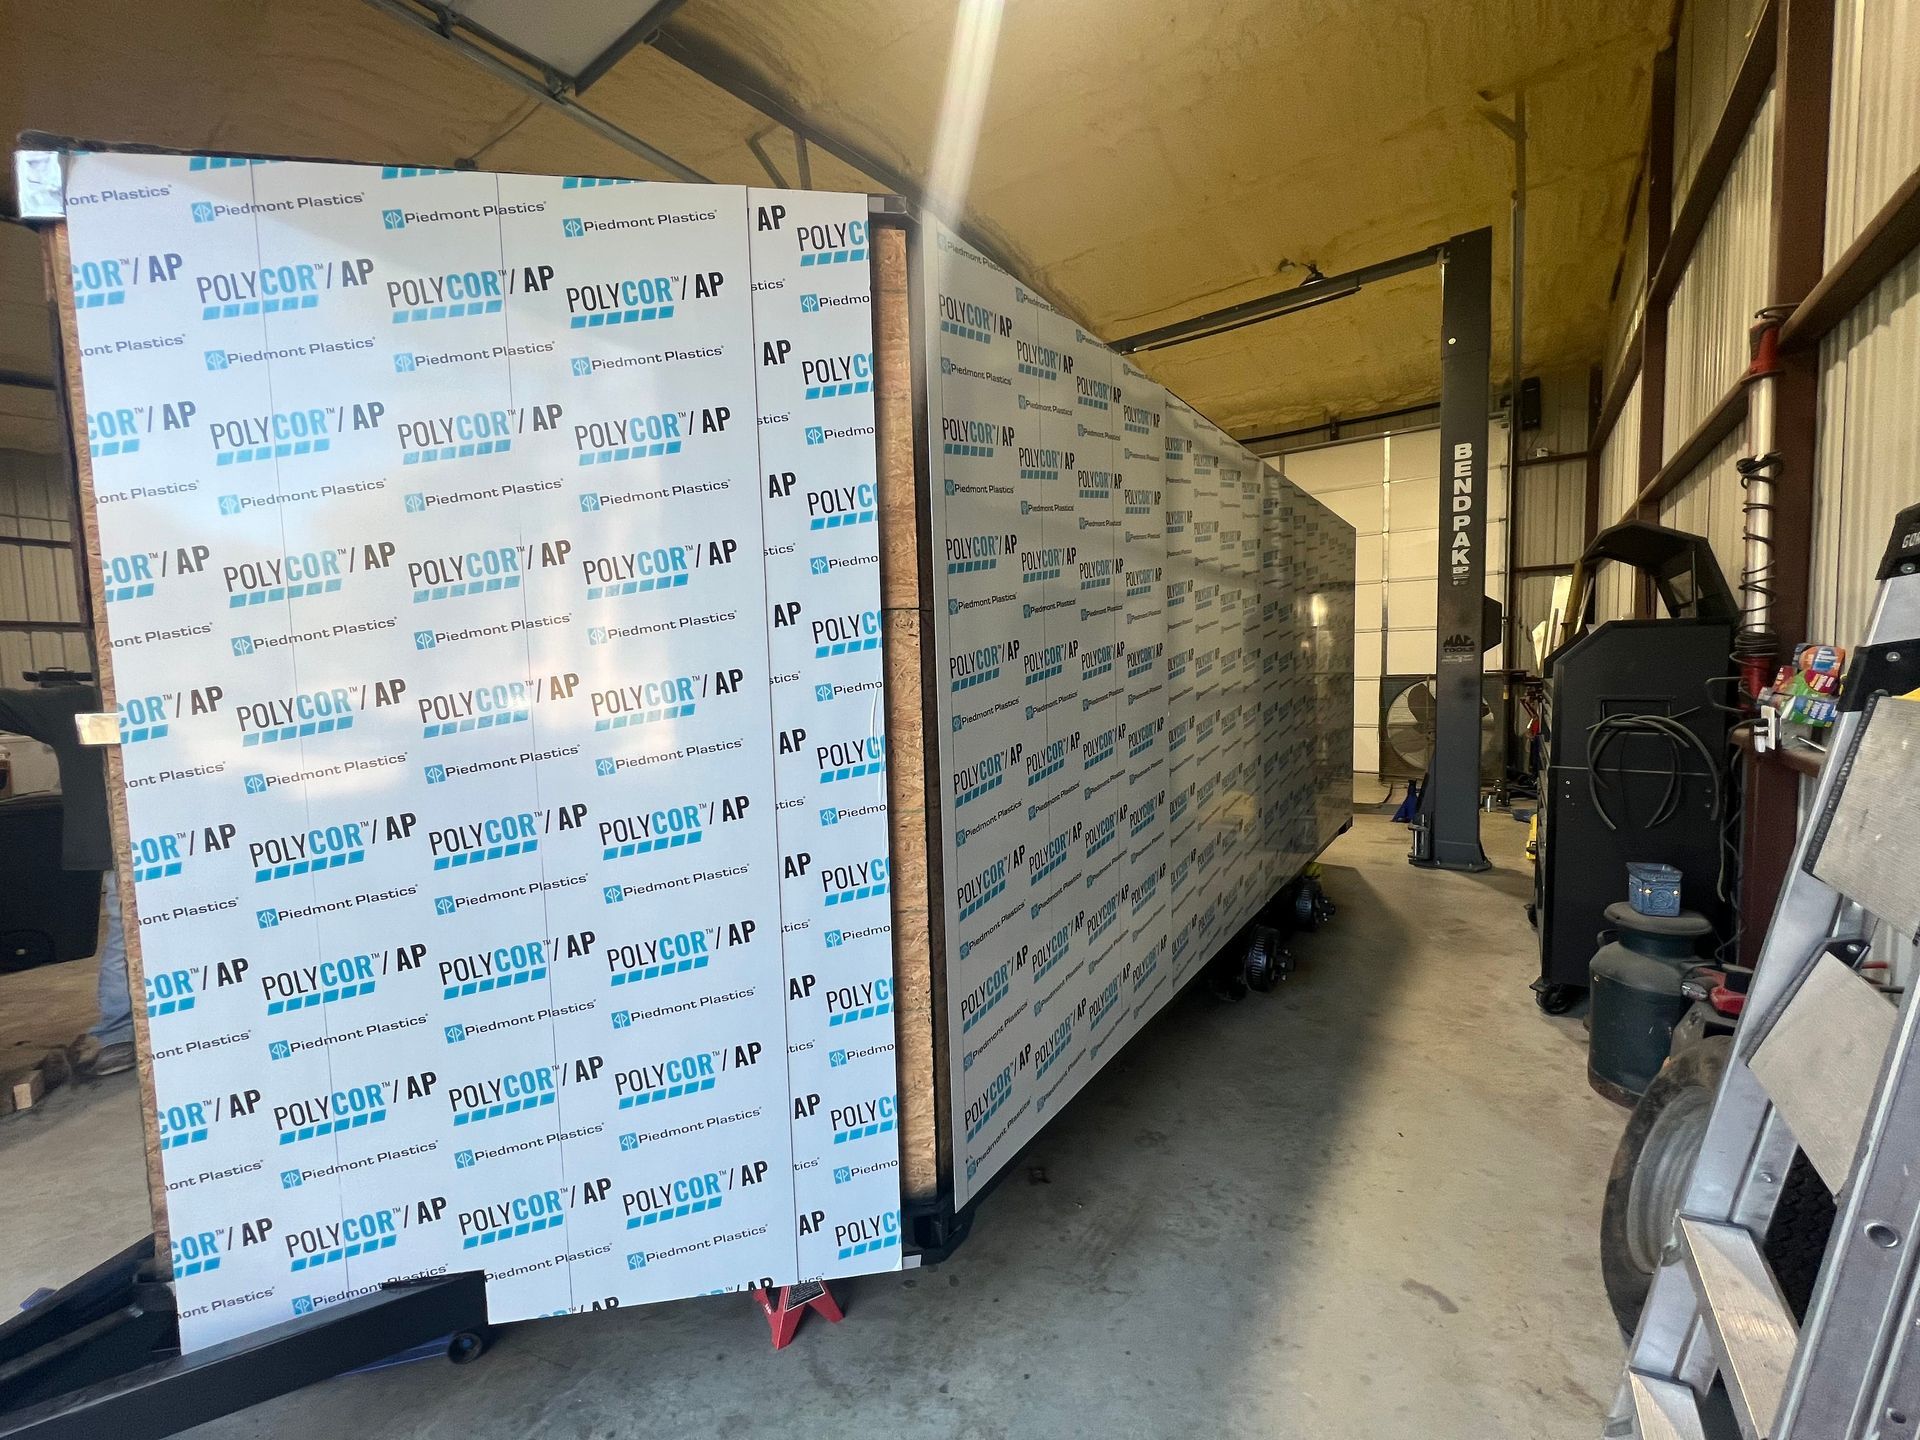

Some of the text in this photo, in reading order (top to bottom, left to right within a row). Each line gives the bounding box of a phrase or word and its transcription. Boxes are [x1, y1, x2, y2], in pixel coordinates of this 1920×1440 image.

[213, 200, 294, 217] Piedmont
[402, 207, 479, 224] Piedmont
[582, 214, 654, 231] Piedmont
[226, 346, 306, 364] Piedmont
[413, 349, 489, 367] Piedmont
[590, 352, 662, 370] Piedmont
[951, 364, 986, 381] Piedmont
[239, 489, 319, 508] Piedmont
[424, 488, 499, 507] Piedmont
[598, 487, 669, 506] Piedmont
[1451, 442, 1473, 565] BENDPAK
[958, 597, 992, 611] Piedmont
[252, 628, 330, 649] Piedmont
[434, 624, 508, 644] Piedmont
[607, 619, 677, 639] Piedmont
[445, 756, 518, 778] Piedmont
[615, 748, 684, 769] Piedmont
[265, 765, 342, 787] Piedmont
[965, 814, 998, 839] Piedmont
[623, 875, 691, 896] Piedmont
[454, 886, 527, 908] Piedmont
[277, 898, 353, 921] Piedmont
[630, 999, 698, 1021] Piedmont
[464, 1013, 536, 1036] Piedmont
[289, 1028, 364, 1052] Piedmont
[638, 1120, 705, 1143] Piedmont
[474, 1137, 544, 1161] Piedmont
[301, 1156, 375, 1181] Piedmont
[645, 1238, 711, 1262] Piedmont
[483, 1259, 553, 1284] Piedmont
